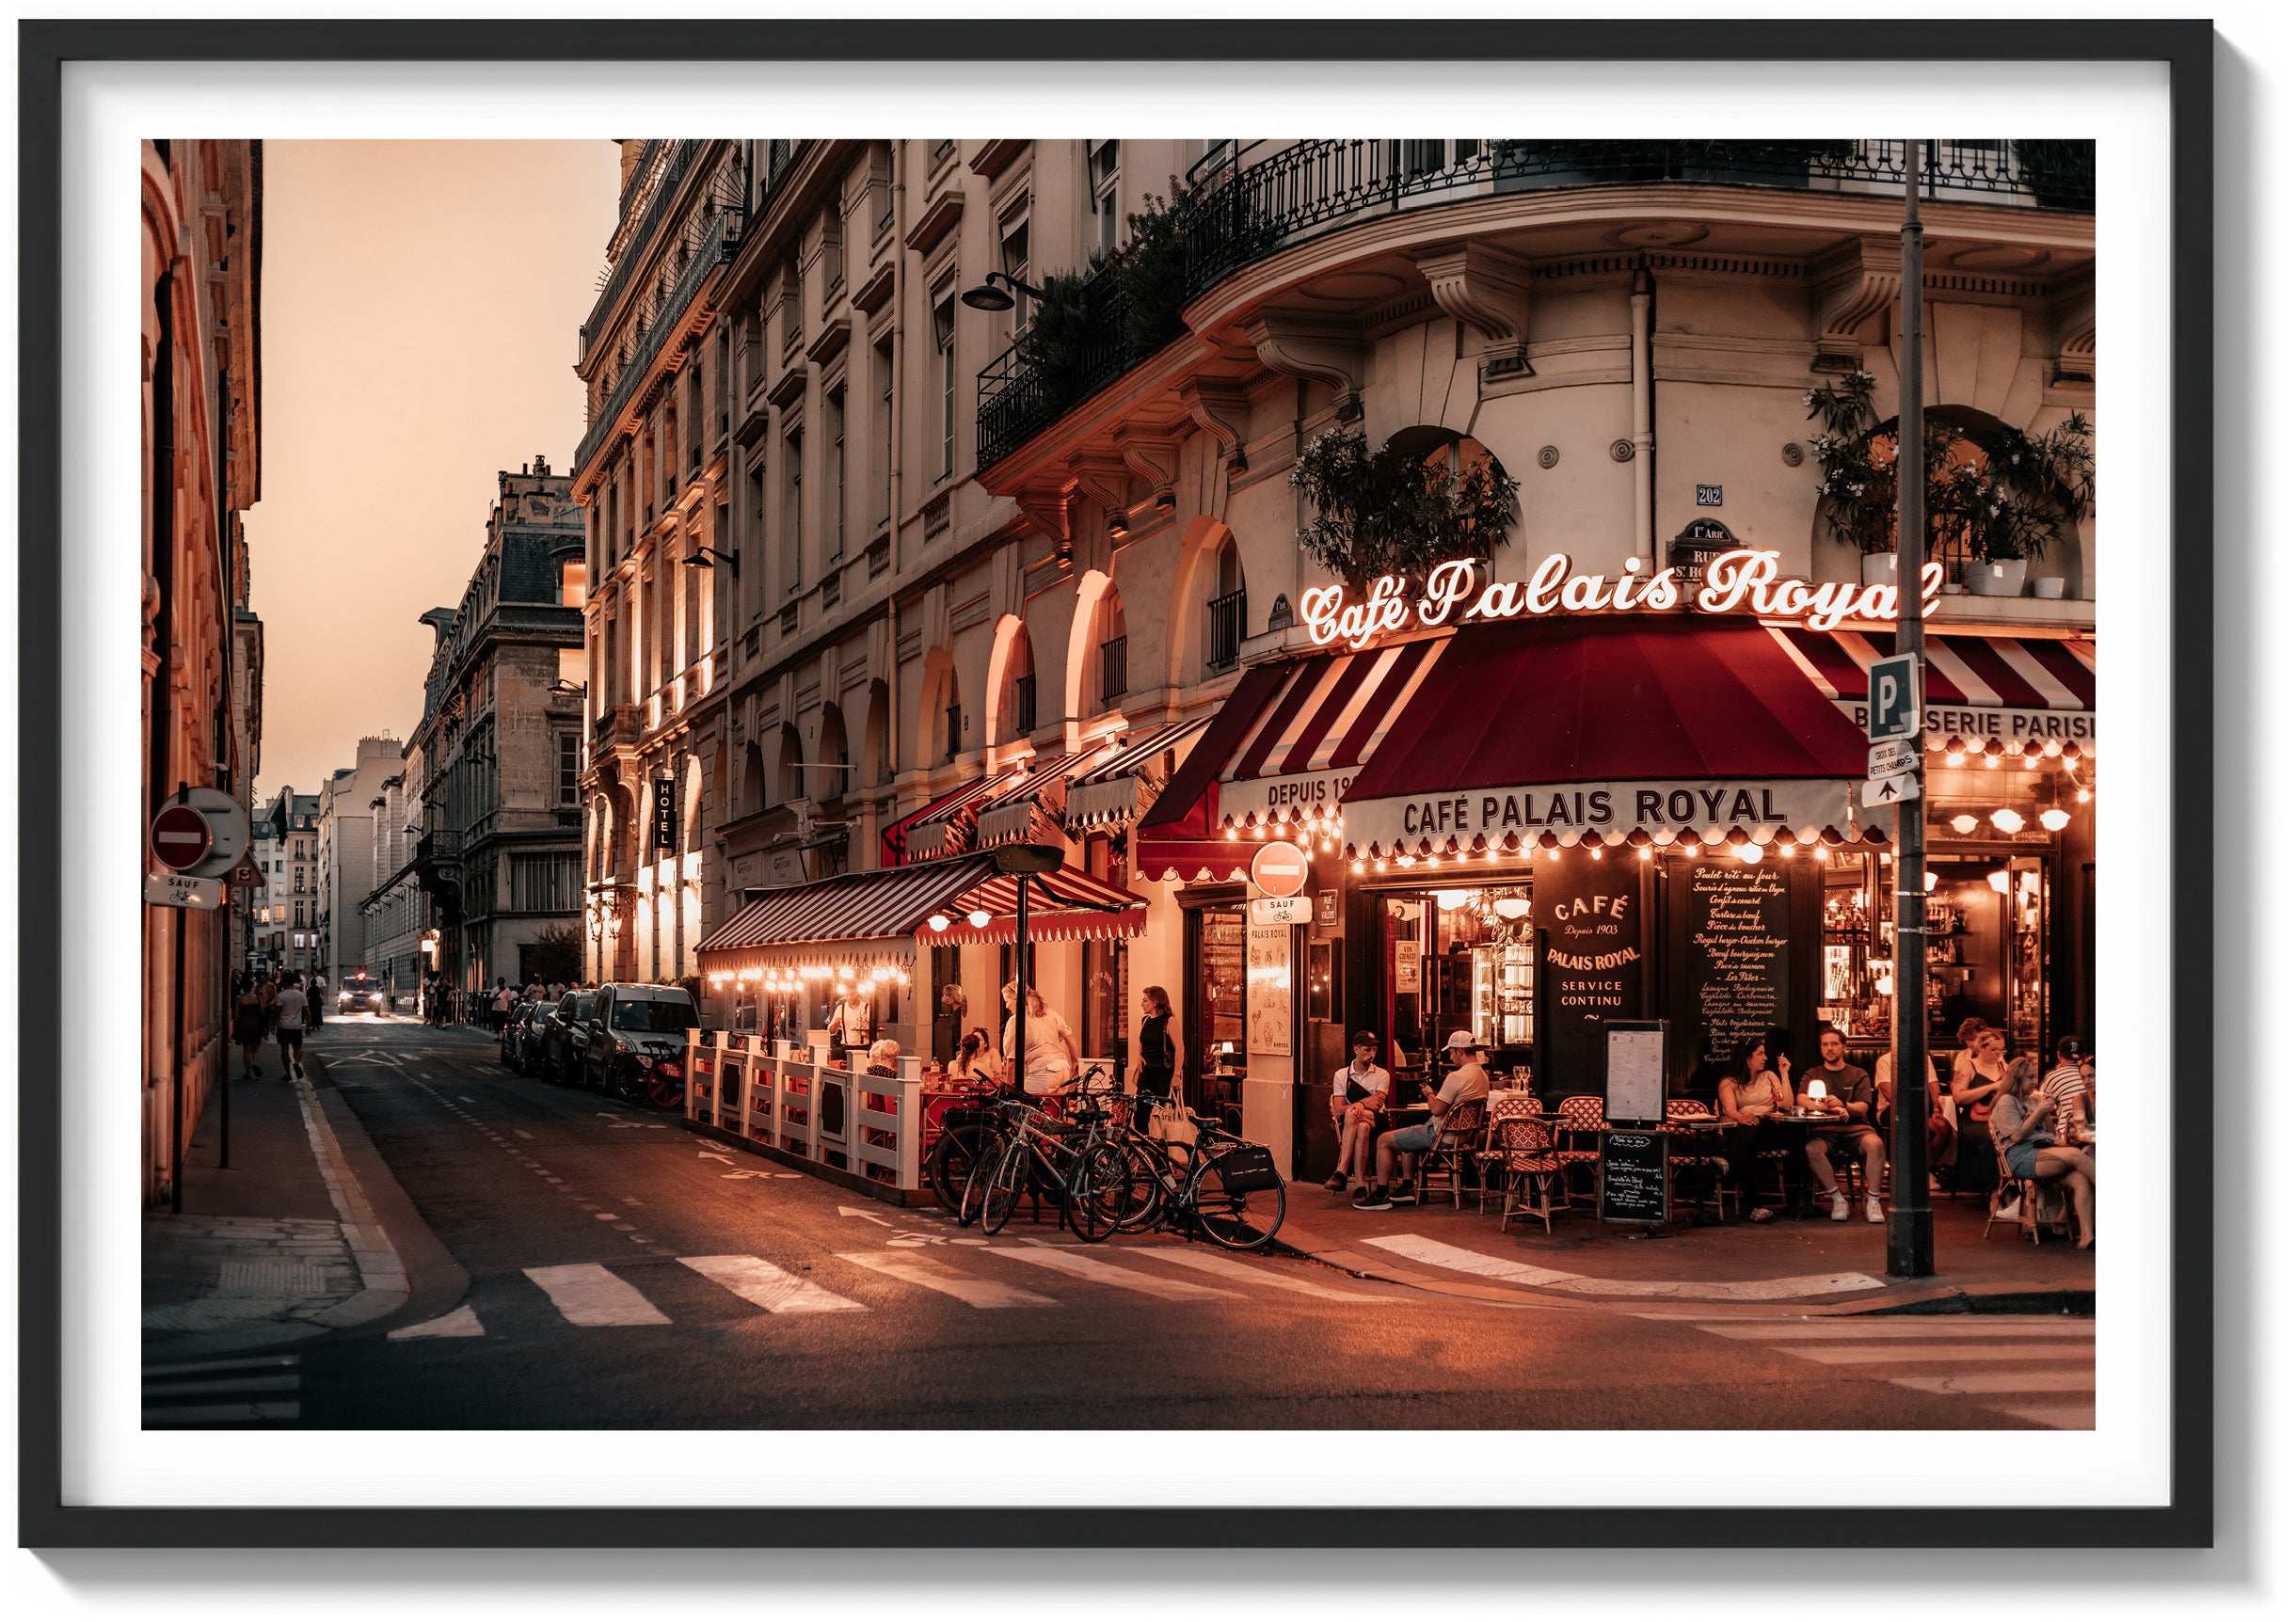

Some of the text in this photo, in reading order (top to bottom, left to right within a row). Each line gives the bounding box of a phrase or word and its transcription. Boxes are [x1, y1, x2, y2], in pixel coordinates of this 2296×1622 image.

[1699, 488, 1720, 503] 202
[1300, 574, 1410, 649] Café
[1418, 553, 1678, 626] Palais
[1878, 675, 1898, 725] P
[1855, 708, 2001, 736] BSERIE
[1875, 747, 1896, 761] CROIX DES
[1870, 755, 1913, 776] PETITS CHAMPS
[1268, 775, 1358, 806] DEPUIS 19
[661, 785, 669, 844] HOTEL
[1404, 787, 1788, 835] CAFÉ PALAIS ROYAL
[1695, 867, 1723, 879] Poulet
[1755, 868, 1779, 885] four
[168, 878, 199, 889] SAUF
[1693, 883, 1717, 892] Souris
[1269, 900, 1294, 909] SAUF
[1323, 896, 1332, 905] RUE
[1710, 895, 1732, 909] Confit
[1555, 895, 1629, 921] CAFÉ
[1564, 925, 1618, 939] Depuis 1903
[1738, 921, 1765, 930] boucher
[1252, 929, 1287, 939] PALAIS ROYAL
[1547, 946, 1641, 971] PALAIS ROYAL
[1561, 981, 1622, 991] SERVICE
[1561, 996, 1622, 1006] CONTINU
